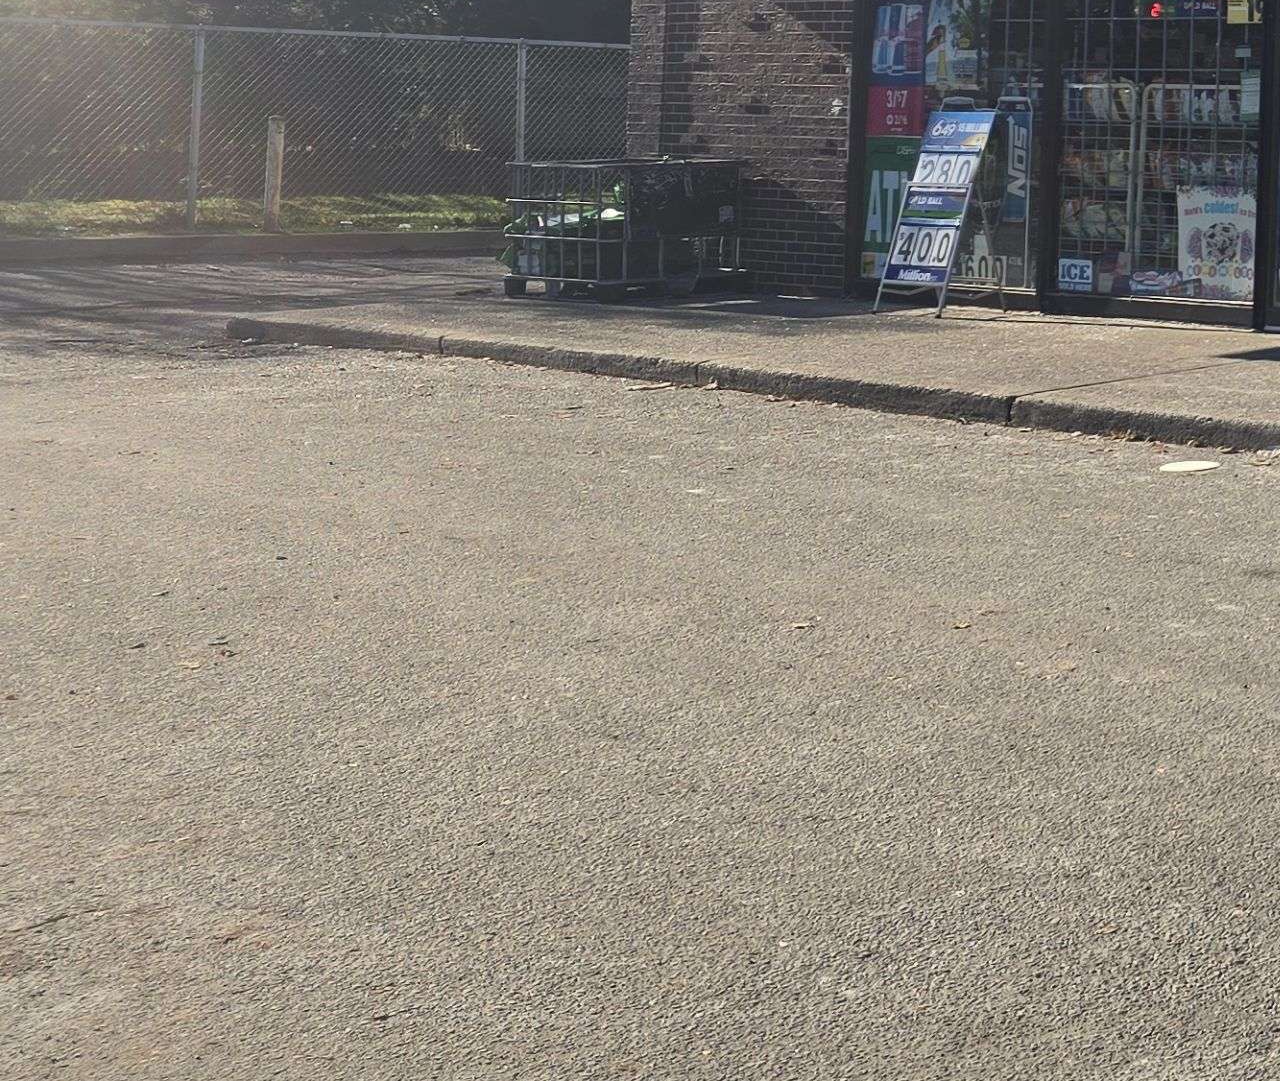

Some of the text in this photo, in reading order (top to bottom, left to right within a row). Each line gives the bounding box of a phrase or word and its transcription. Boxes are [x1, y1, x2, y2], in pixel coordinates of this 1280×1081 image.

[865, 170, 908, 243] AT
[898, 268, 931, 281] Million
[1061, 263, 1091, 280] ICE
